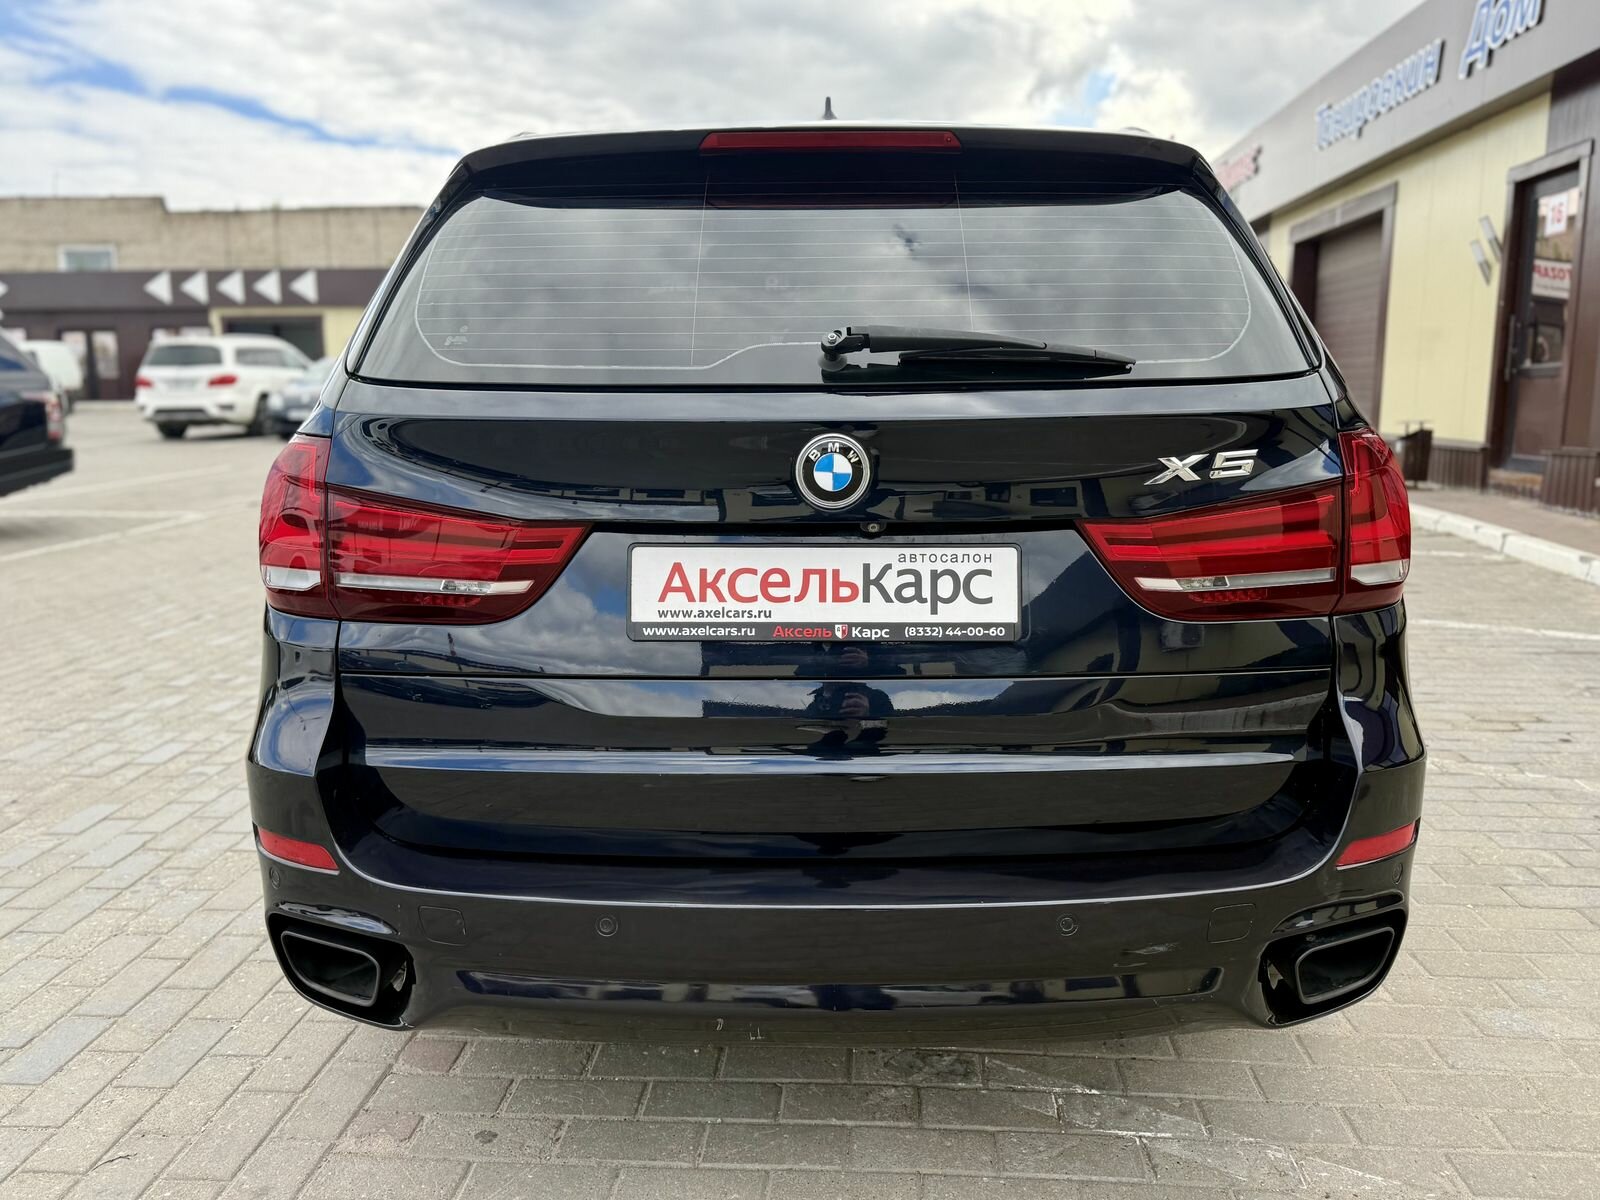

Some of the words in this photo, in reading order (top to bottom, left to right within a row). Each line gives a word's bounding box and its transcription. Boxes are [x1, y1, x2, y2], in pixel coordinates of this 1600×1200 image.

[1458, 0, 1546, 79] Дом
[808, 442, 860, 463] BMW
[1143, 448, 1259, 486] X5
[897, 553, 993, 564] автосалон
[658, 561, 993, 616] АксельКарс
[657, 607, 772, 619] www.axelcars.ru
[642, 625, 756, 637] www.axelcars.ru
[772, 625, 833, 638] Аксель
[851, 626, 890, 640] Карс
[904, 626, 943, 638] (8332)
[945, 627, 1006, 637] 44-00-60
